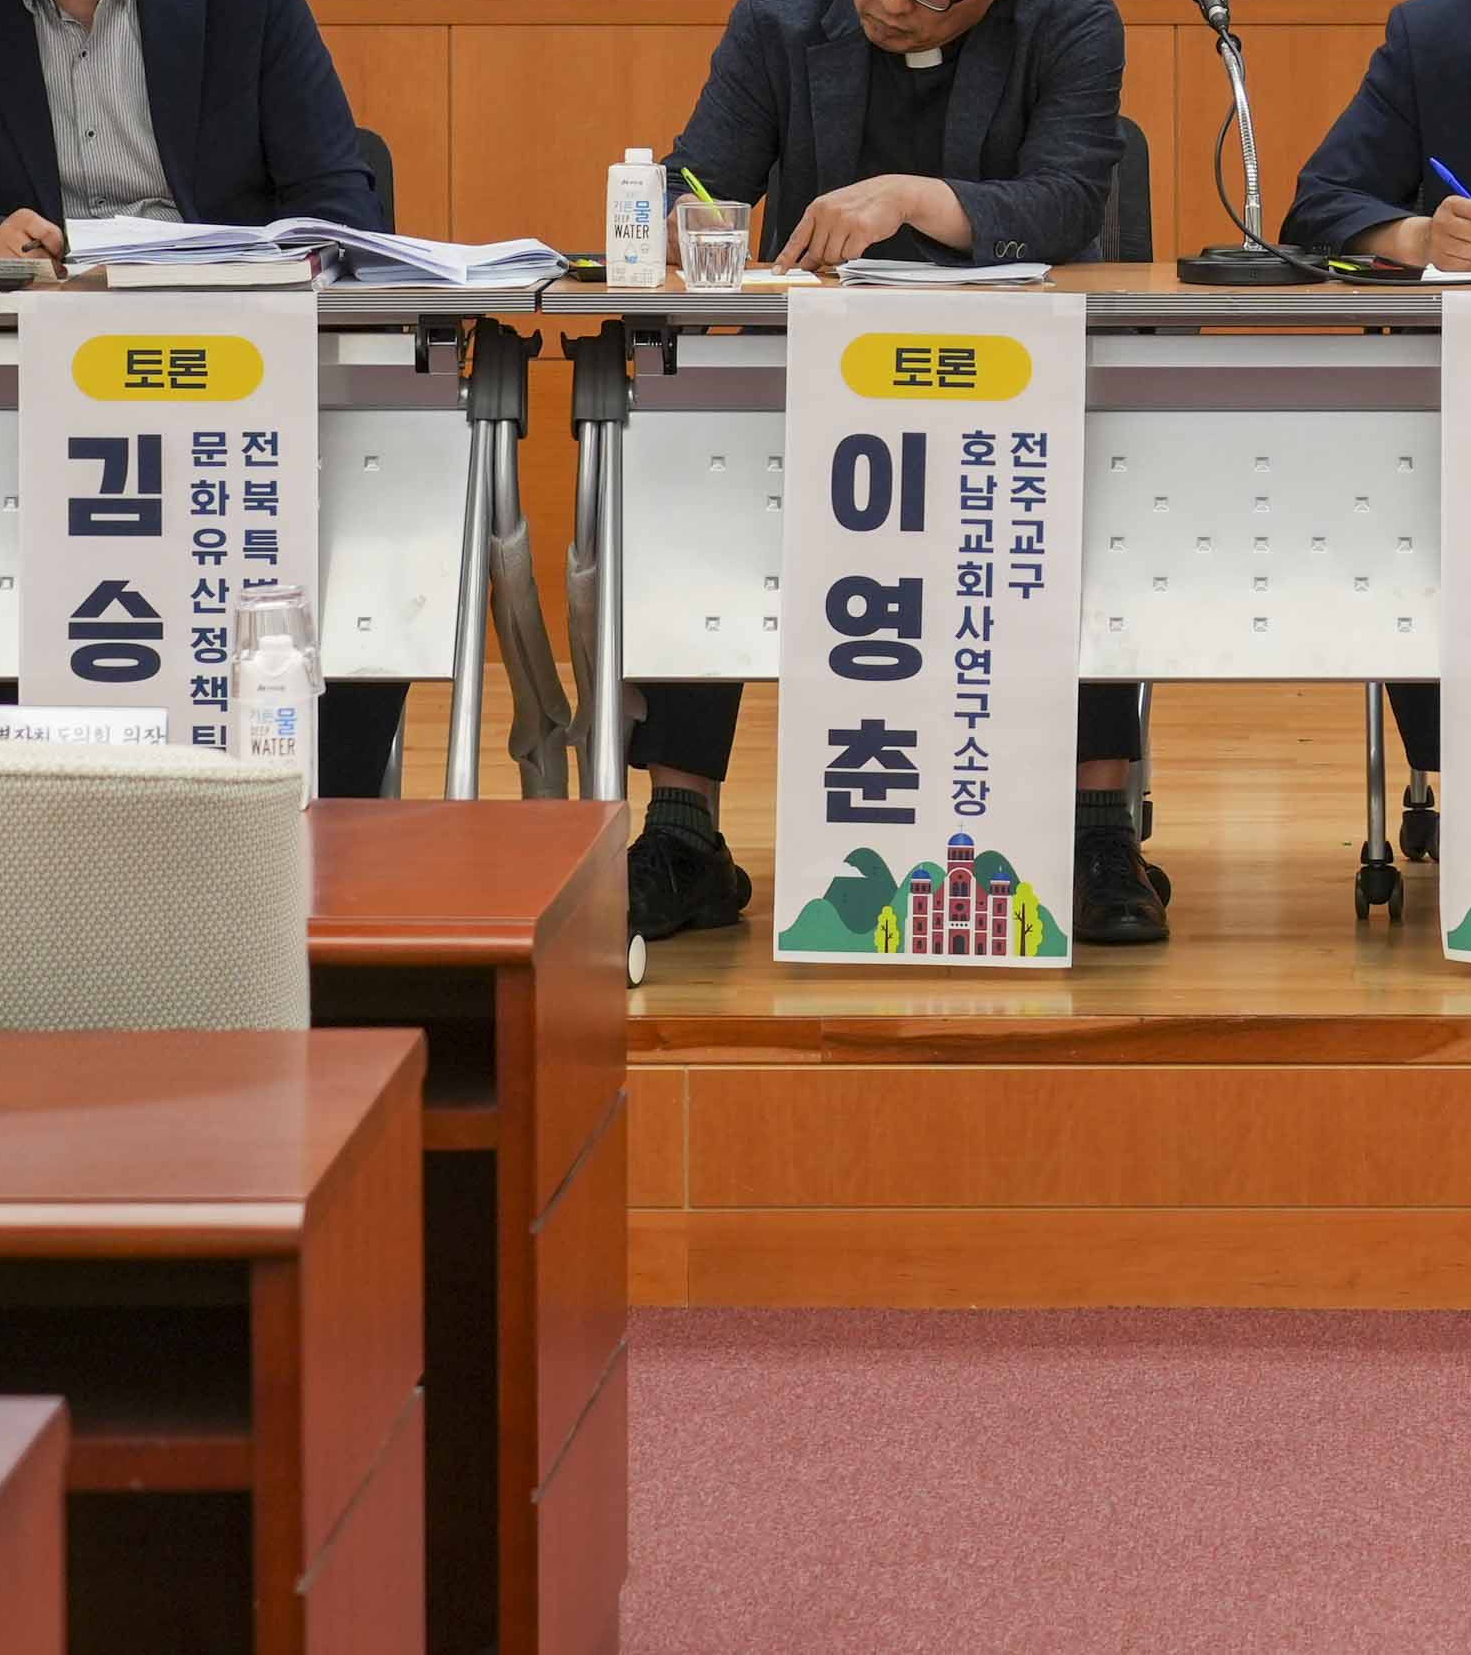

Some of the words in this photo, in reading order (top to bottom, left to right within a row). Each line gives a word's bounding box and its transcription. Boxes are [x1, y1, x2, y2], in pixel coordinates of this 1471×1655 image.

[614, 225, 649, 239] WATER
[125, 350, 207, 388] 토론
[893, 348, 976, 388] 토론
[68, 435, 163, 682] 김승
[242, 432, 278, 588] 전북특
[1009, 433, 1047, 599] 전주교구
[824, 433, 926, 824] 이영춘
[952, 430, 997, 815] 호남교회사연구소장
[251, 738, 295, 756] WATER
